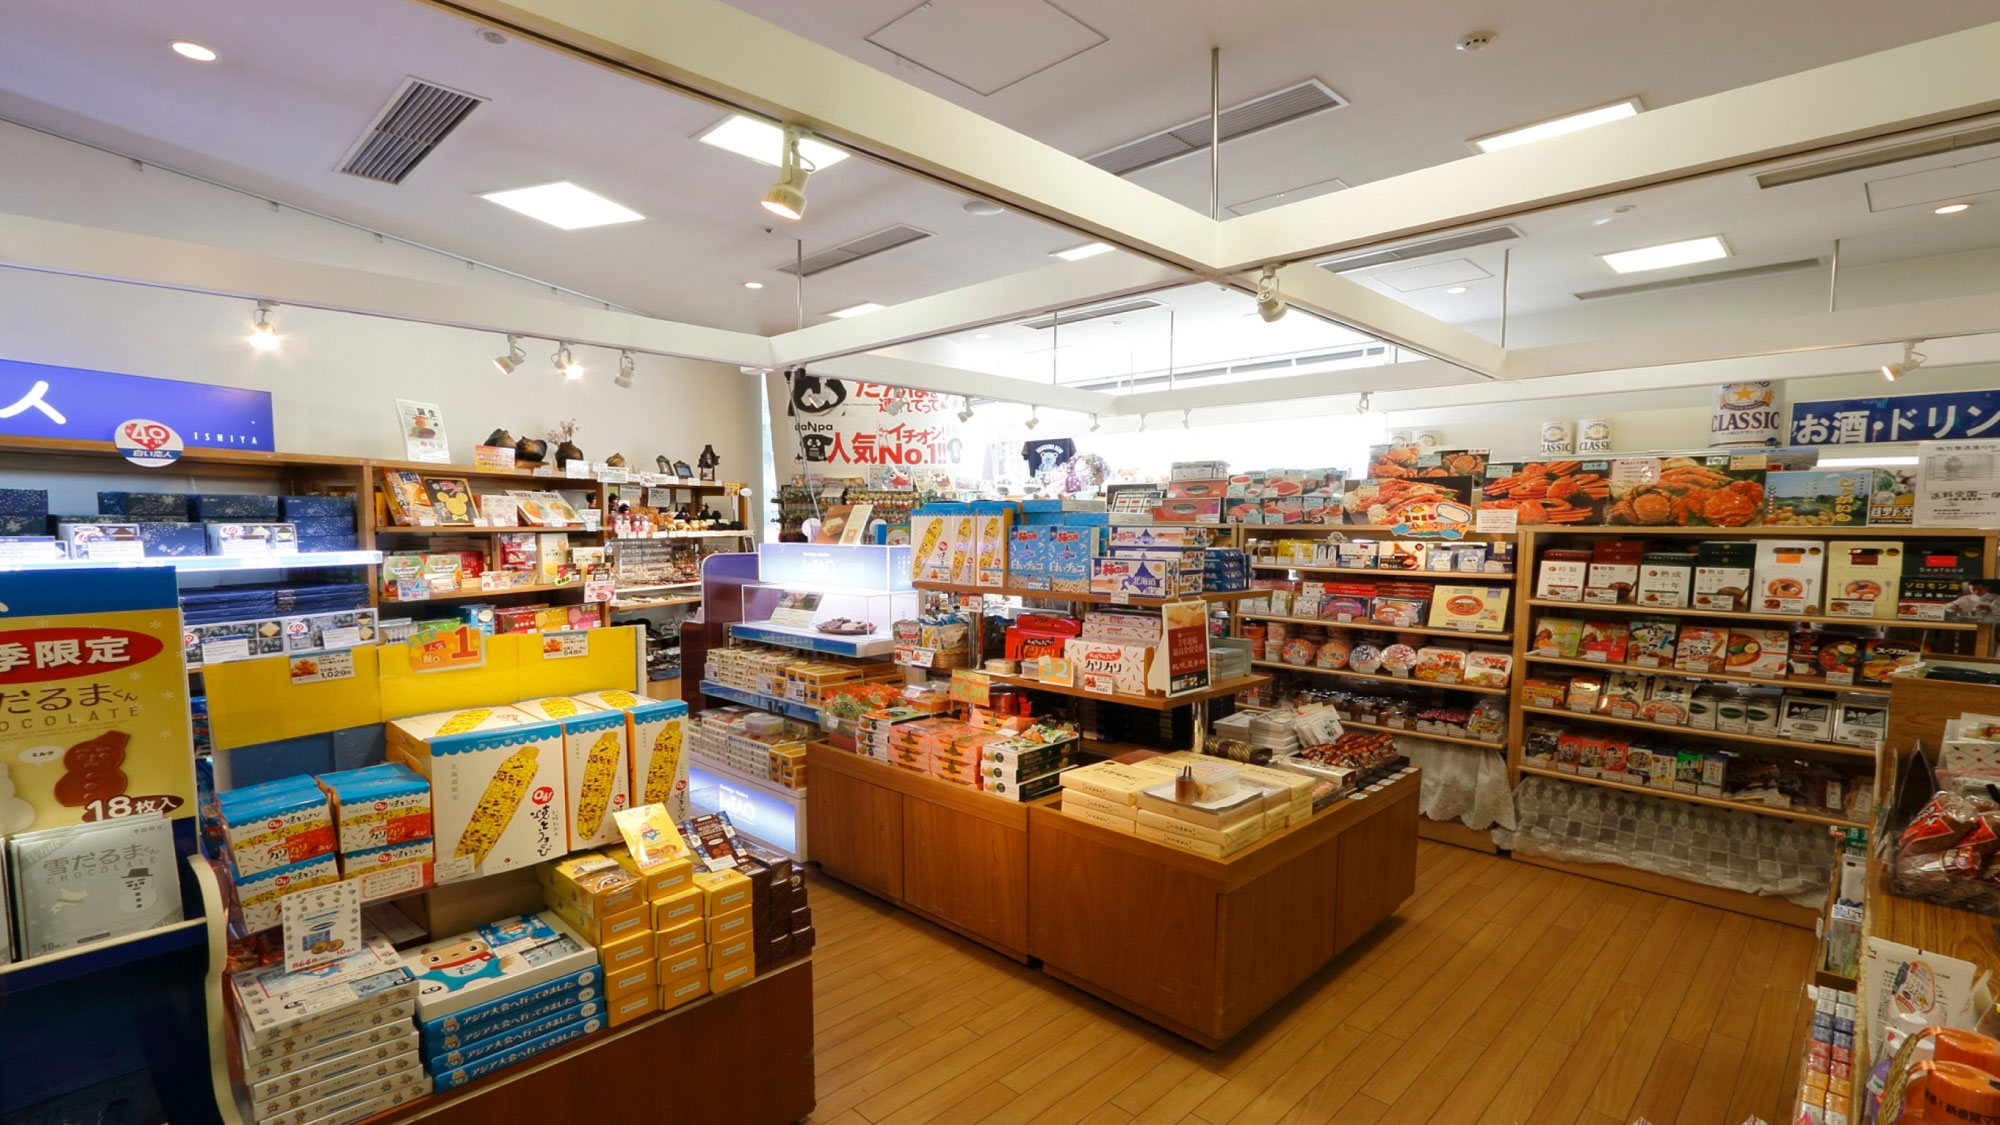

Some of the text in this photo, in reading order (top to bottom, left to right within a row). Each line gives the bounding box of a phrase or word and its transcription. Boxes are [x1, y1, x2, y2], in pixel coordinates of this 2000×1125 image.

[1712, 411, 1780, 433] CLASSIC
[1541, 442, 1571, 453] LASSIC
[1011, 559, 1044, 571] 白いチョコ
[1050, 561, 1086, 574] 白いチョコ
[451, 626, 479, 660] 1
[1084, 661, 1122, 673] カリカリ
[321, 671, 353, 679] 1,029円
[87, 797, 177, 821] 18枚入
[44, 844, 160, 876] 雪だるまくん
